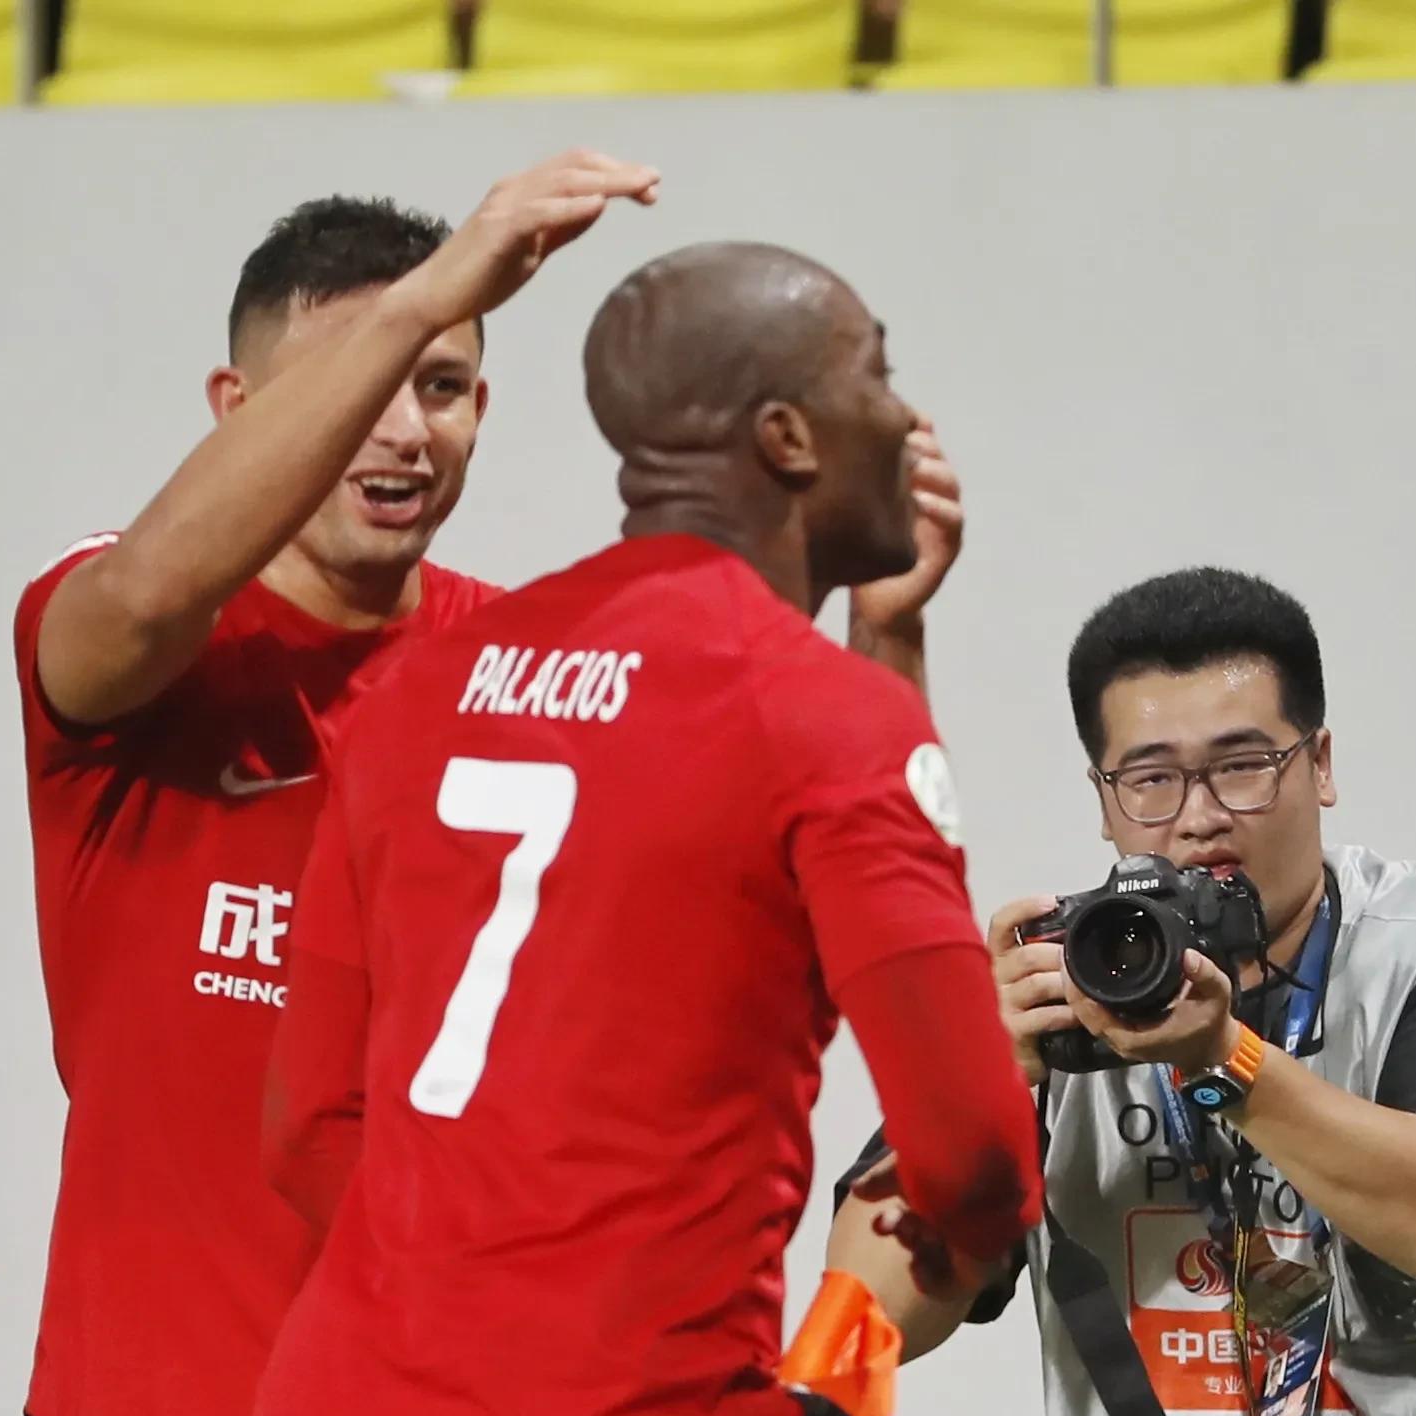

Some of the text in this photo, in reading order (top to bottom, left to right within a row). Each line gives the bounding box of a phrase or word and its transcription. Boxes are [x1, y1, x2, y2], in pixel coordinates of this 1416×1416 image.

[456, 643, 643, 724] PALACIOS
[1116, 877, 1160, 895] Nikon
[408, 756, 577, 1120] 7
